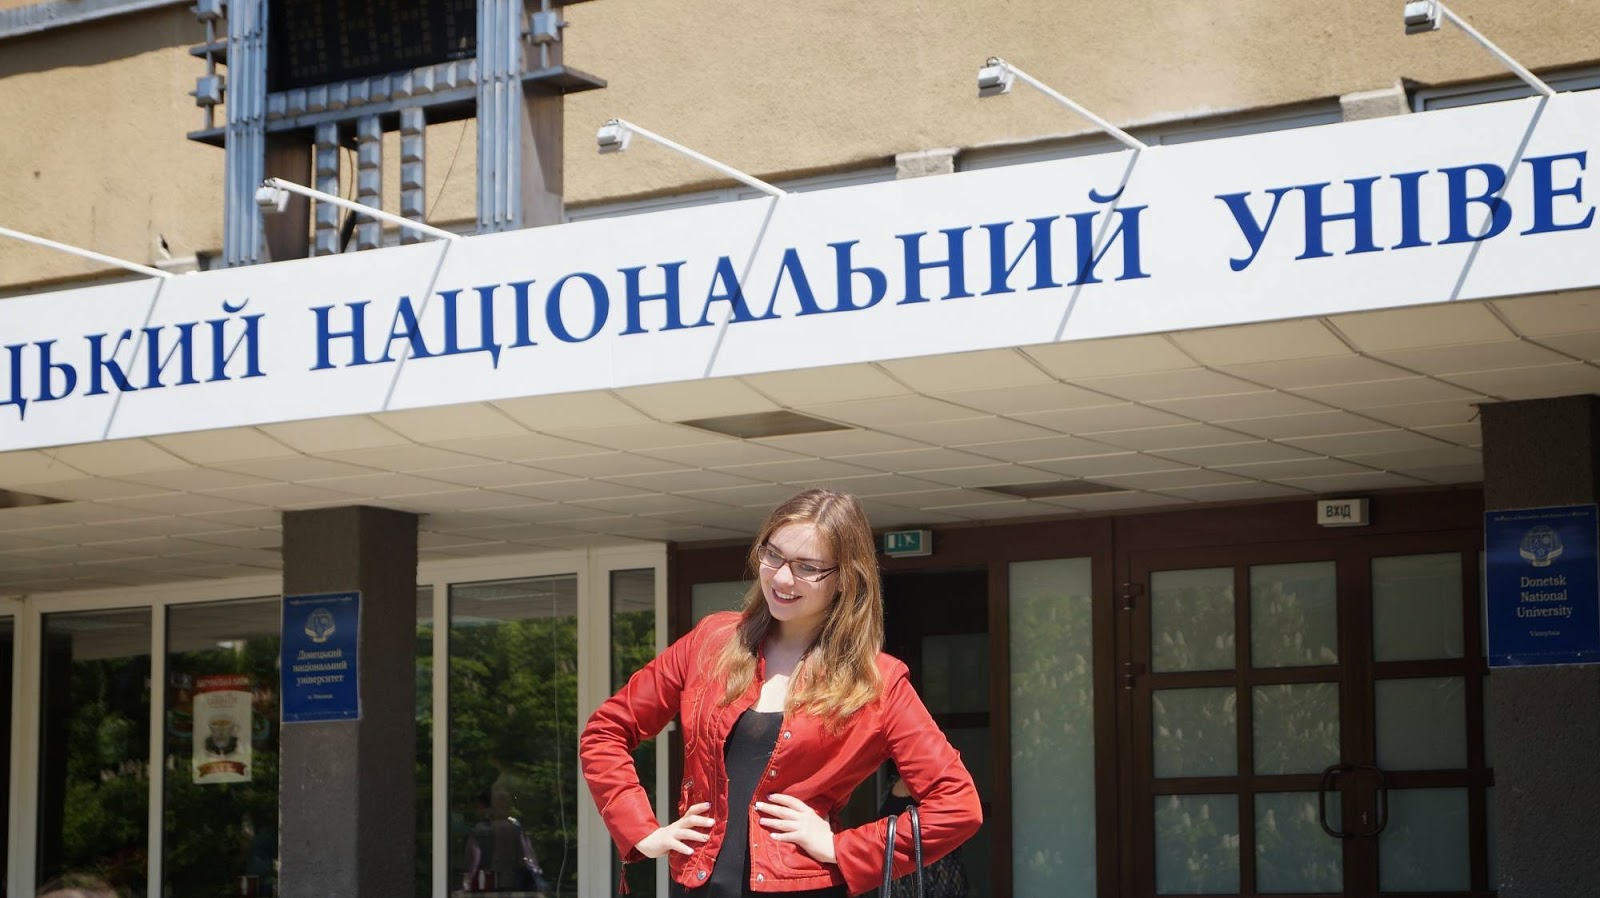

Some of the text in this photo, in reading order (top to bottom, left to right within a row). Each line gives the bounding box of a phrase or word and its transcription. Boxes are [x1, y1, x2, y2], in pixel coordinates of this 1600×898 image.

[310, 187, 1149, 369] НАЦІОНАЛЬНИЙ
[1214, 150, 1596, 271] УНІВЕ
[1326, 504, 1352, 519] ВХІД
[1520, 574, 1567, 588] Donetsk
[1520, 589, 1568, 603] National
[1516, 604, 1573, 619] University
[297, 648, 342, 660] Донецький
